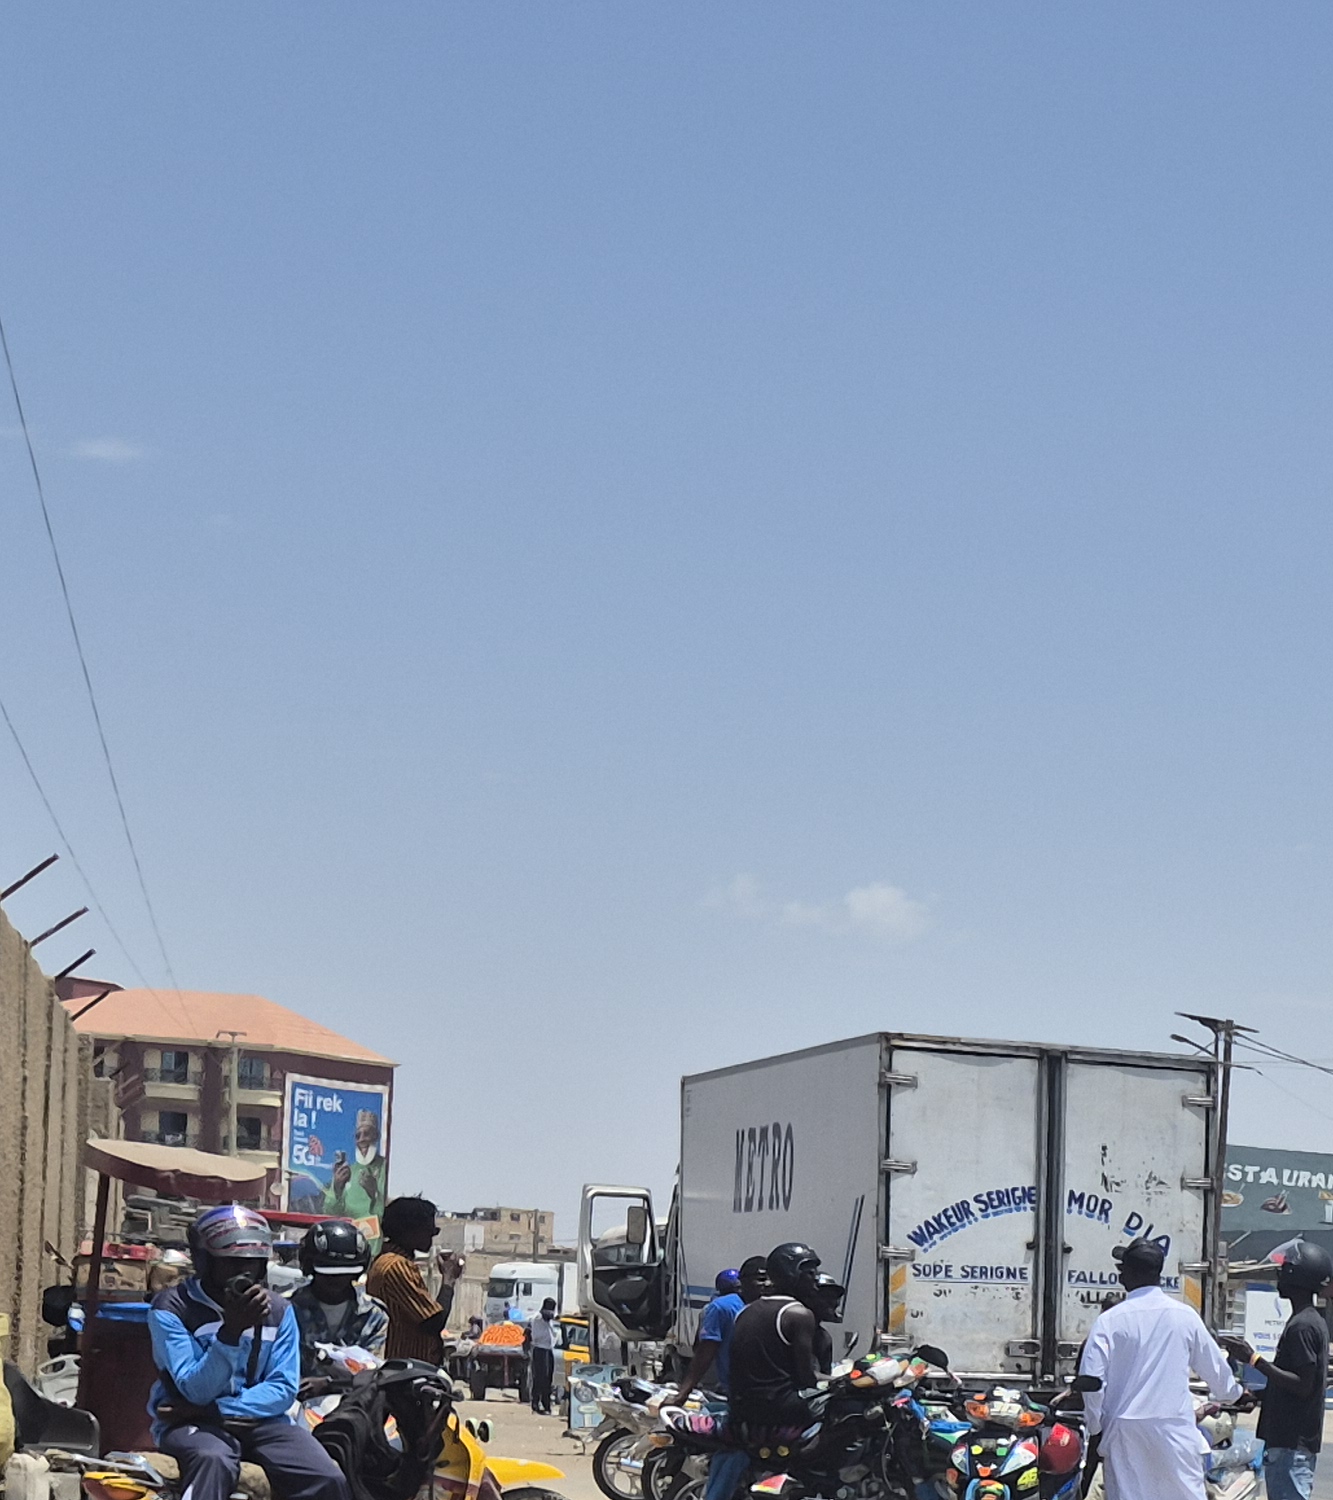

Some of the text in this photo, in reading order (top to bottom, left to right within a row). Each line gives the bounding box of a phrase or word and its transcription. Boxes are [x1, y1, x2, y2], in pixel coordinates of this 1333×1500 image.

[316, 1093, 343, 1113] rek
[292, 1144, 315, 1166] 5G
[733, 1122, 794, 1213] METRO
[906, 1199, 976, 1250] WAKEUR
[1067, 1189, 1113, 1222] MOR
[911, 1262, 953, 1279] SOPE
[960, 1264, 1029, 1281] SERIGNE
[1067, 1269, 1120, 1286] FALLO
